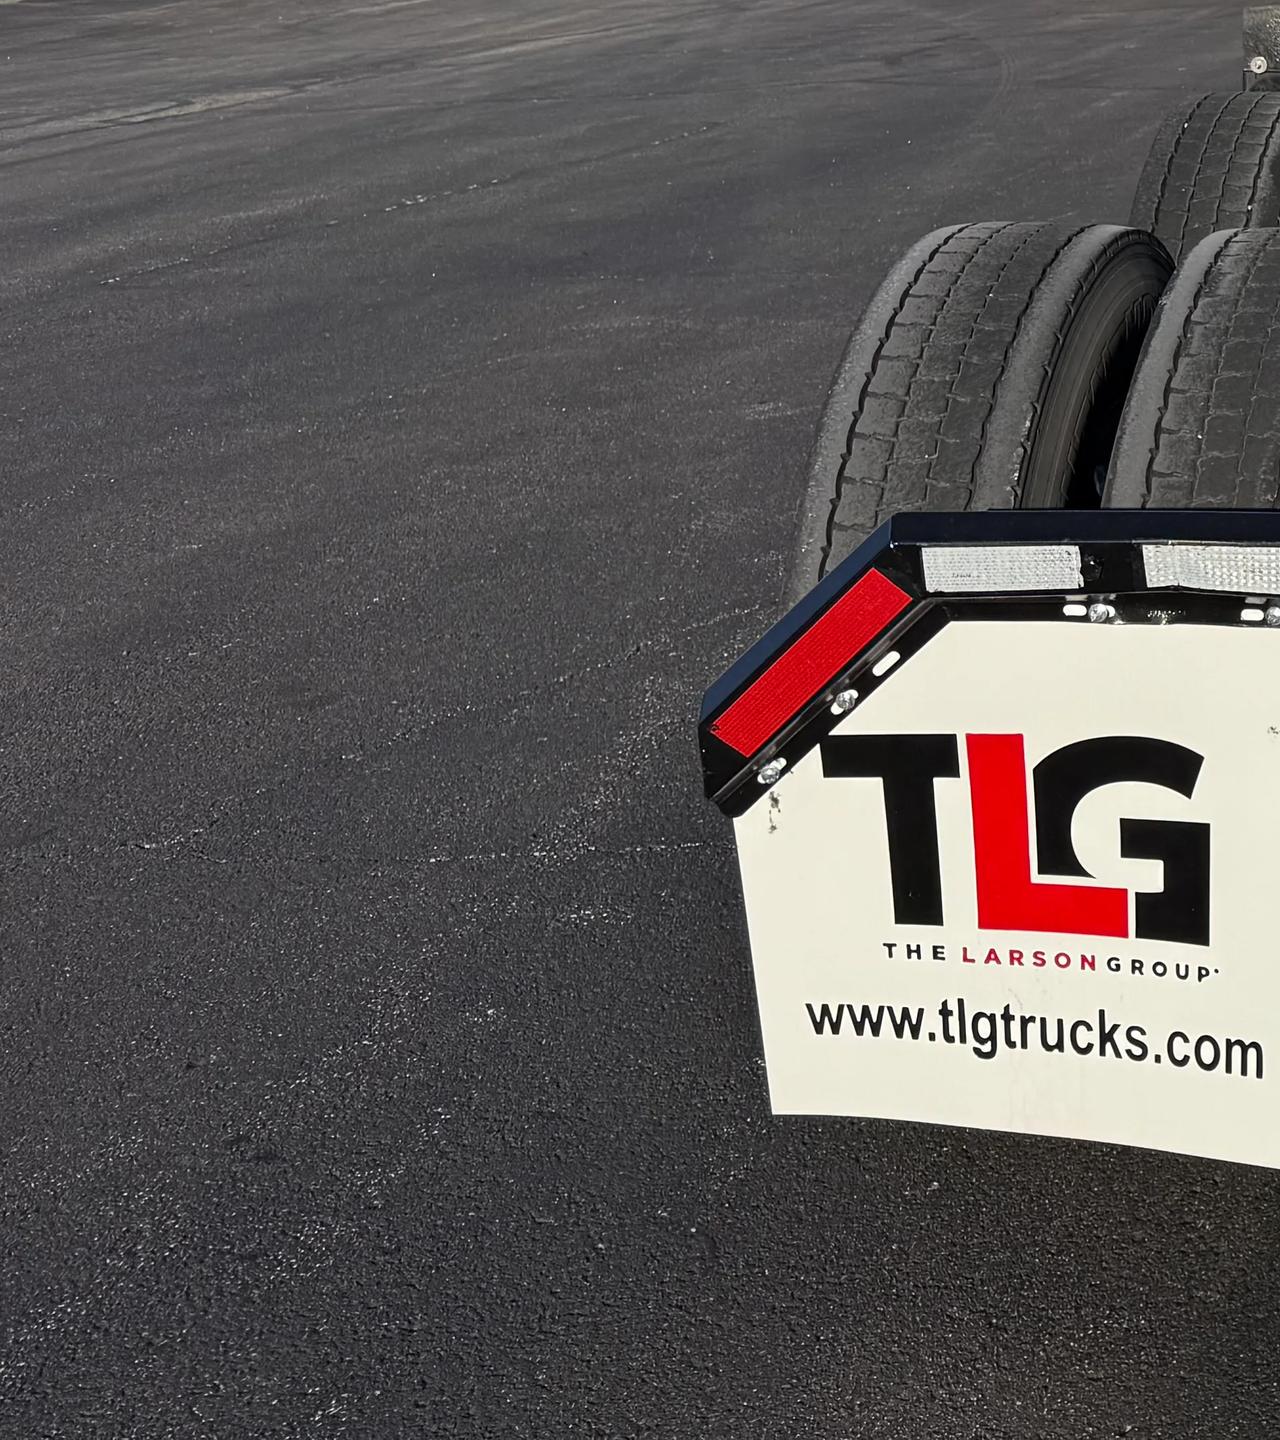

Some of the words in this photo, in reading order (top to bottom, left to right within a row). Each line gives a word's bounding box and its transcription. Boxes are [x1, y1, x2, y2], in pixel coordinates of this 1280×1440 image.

[819, 732, 1212, 947] TLG
[882, 942, 946, 961] THE
[805, 997, 1264, 1080] www.tlgtrucks.com
